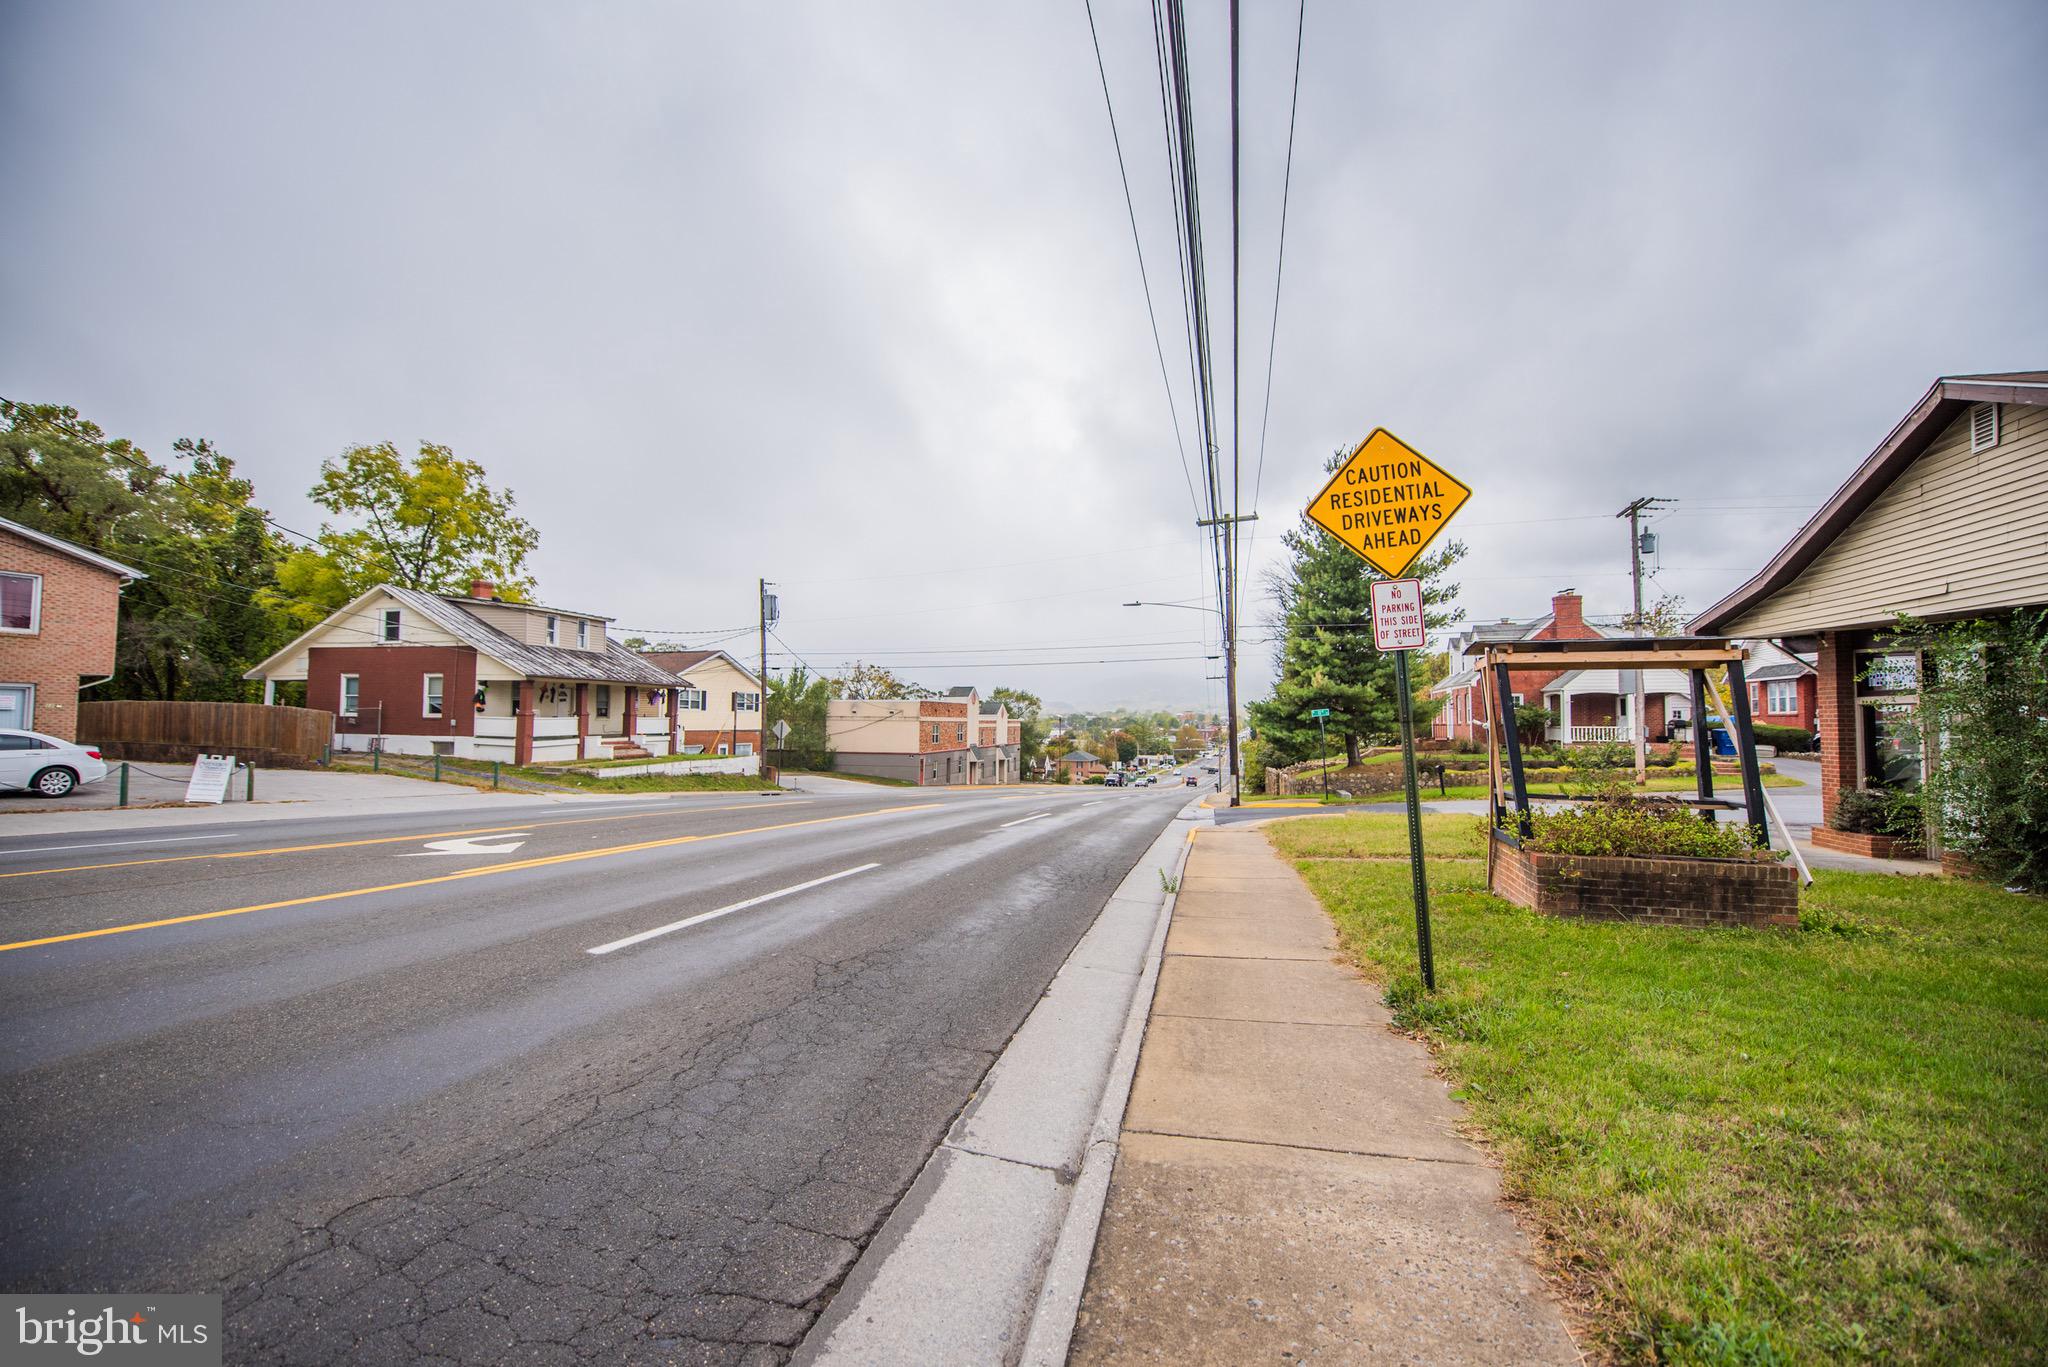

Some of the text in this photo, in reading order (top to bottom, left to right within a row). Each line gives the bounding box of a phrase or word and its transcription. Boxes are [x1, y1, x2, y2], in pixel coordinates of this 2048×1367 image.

[1346, 460, 1421, 486] CAUTION
[1330, 481, 1445, 510] RESIDENTIAL
[1342, 503, 1442, 531] DRIVEWAYS
[1363, 528, 1421, 550] AHEAD
[1391, 590, 1402, 599] NO
[1381, 602, 1415, 613] PARKING
[1380, 615, 1418, 626] THIS SIDE
[1380, 628, 1420, 640] OF STREET
